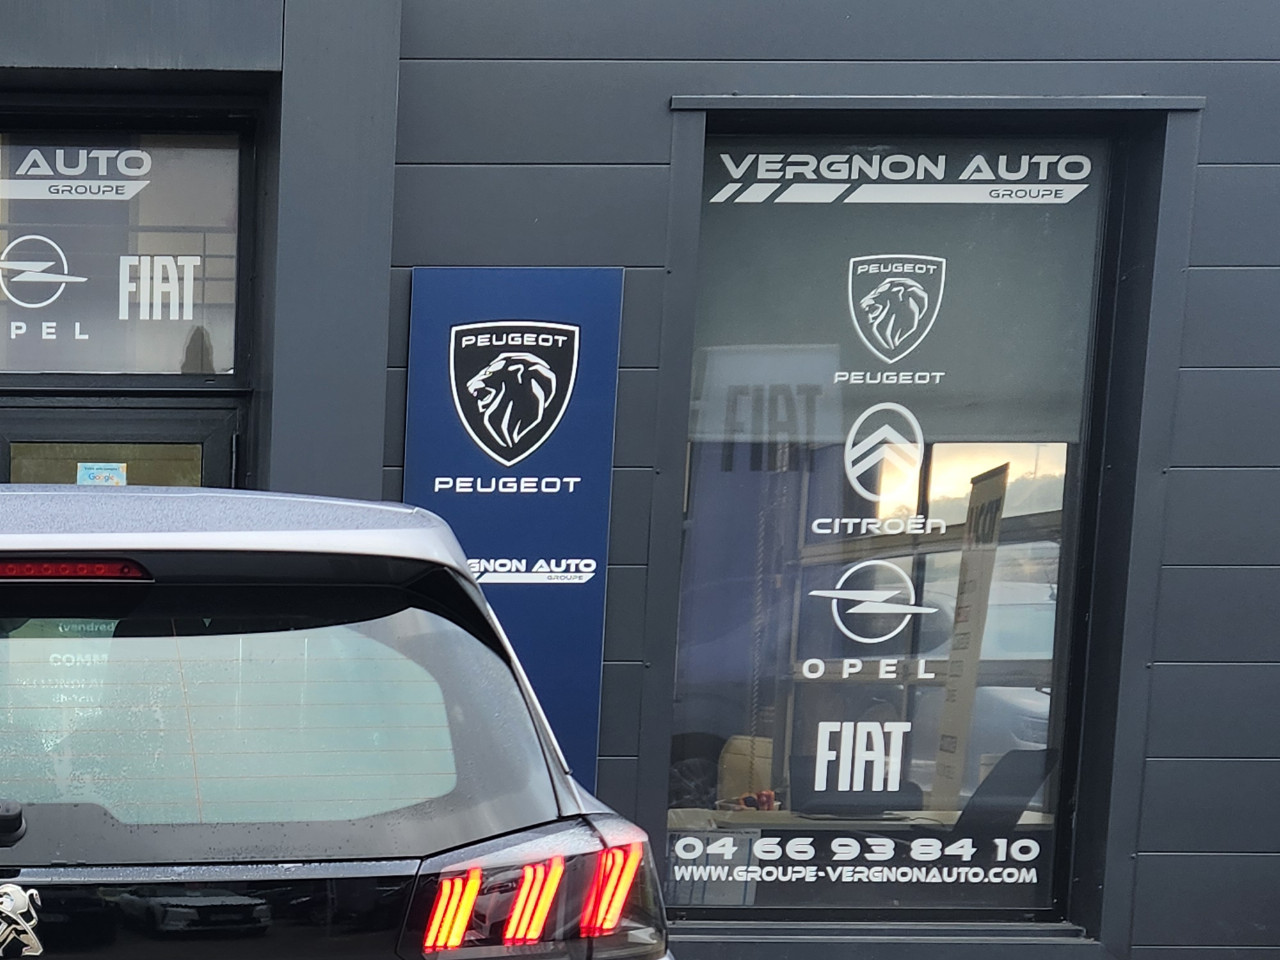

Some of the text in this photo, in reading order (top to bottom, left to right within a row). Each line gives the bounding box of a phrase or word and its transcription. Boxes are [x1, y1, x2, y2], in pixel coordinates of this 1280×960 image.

[15, 149, 152, 176] AUTO
[720, 154, 1092, 181] VERGNON AUTO
[48, 184, 125, 196] GROUPE
[989, 189, 1064, 199] GROUPE
[856, 263, 938, 275] PEUGEOT
[119, 255, 201, 320] FIAT
[461, 333, 568, 348] PEUGEOT
[833, 371, 946, 385] PEUGEOT
[88, 473, 114, 482] Google
[434, 477, 582, 493] PEUGEOT
[531, 558, 597, 573] AUTO
[802, 657, 936, 680] OPEL
[814, 721, 912, 792] FIAT
[674, 836, 1040, 861] 04 66 93 84 10
[673, 865, 1038, 884] WWW.GROUPE-VERGNONAUTO.COM
